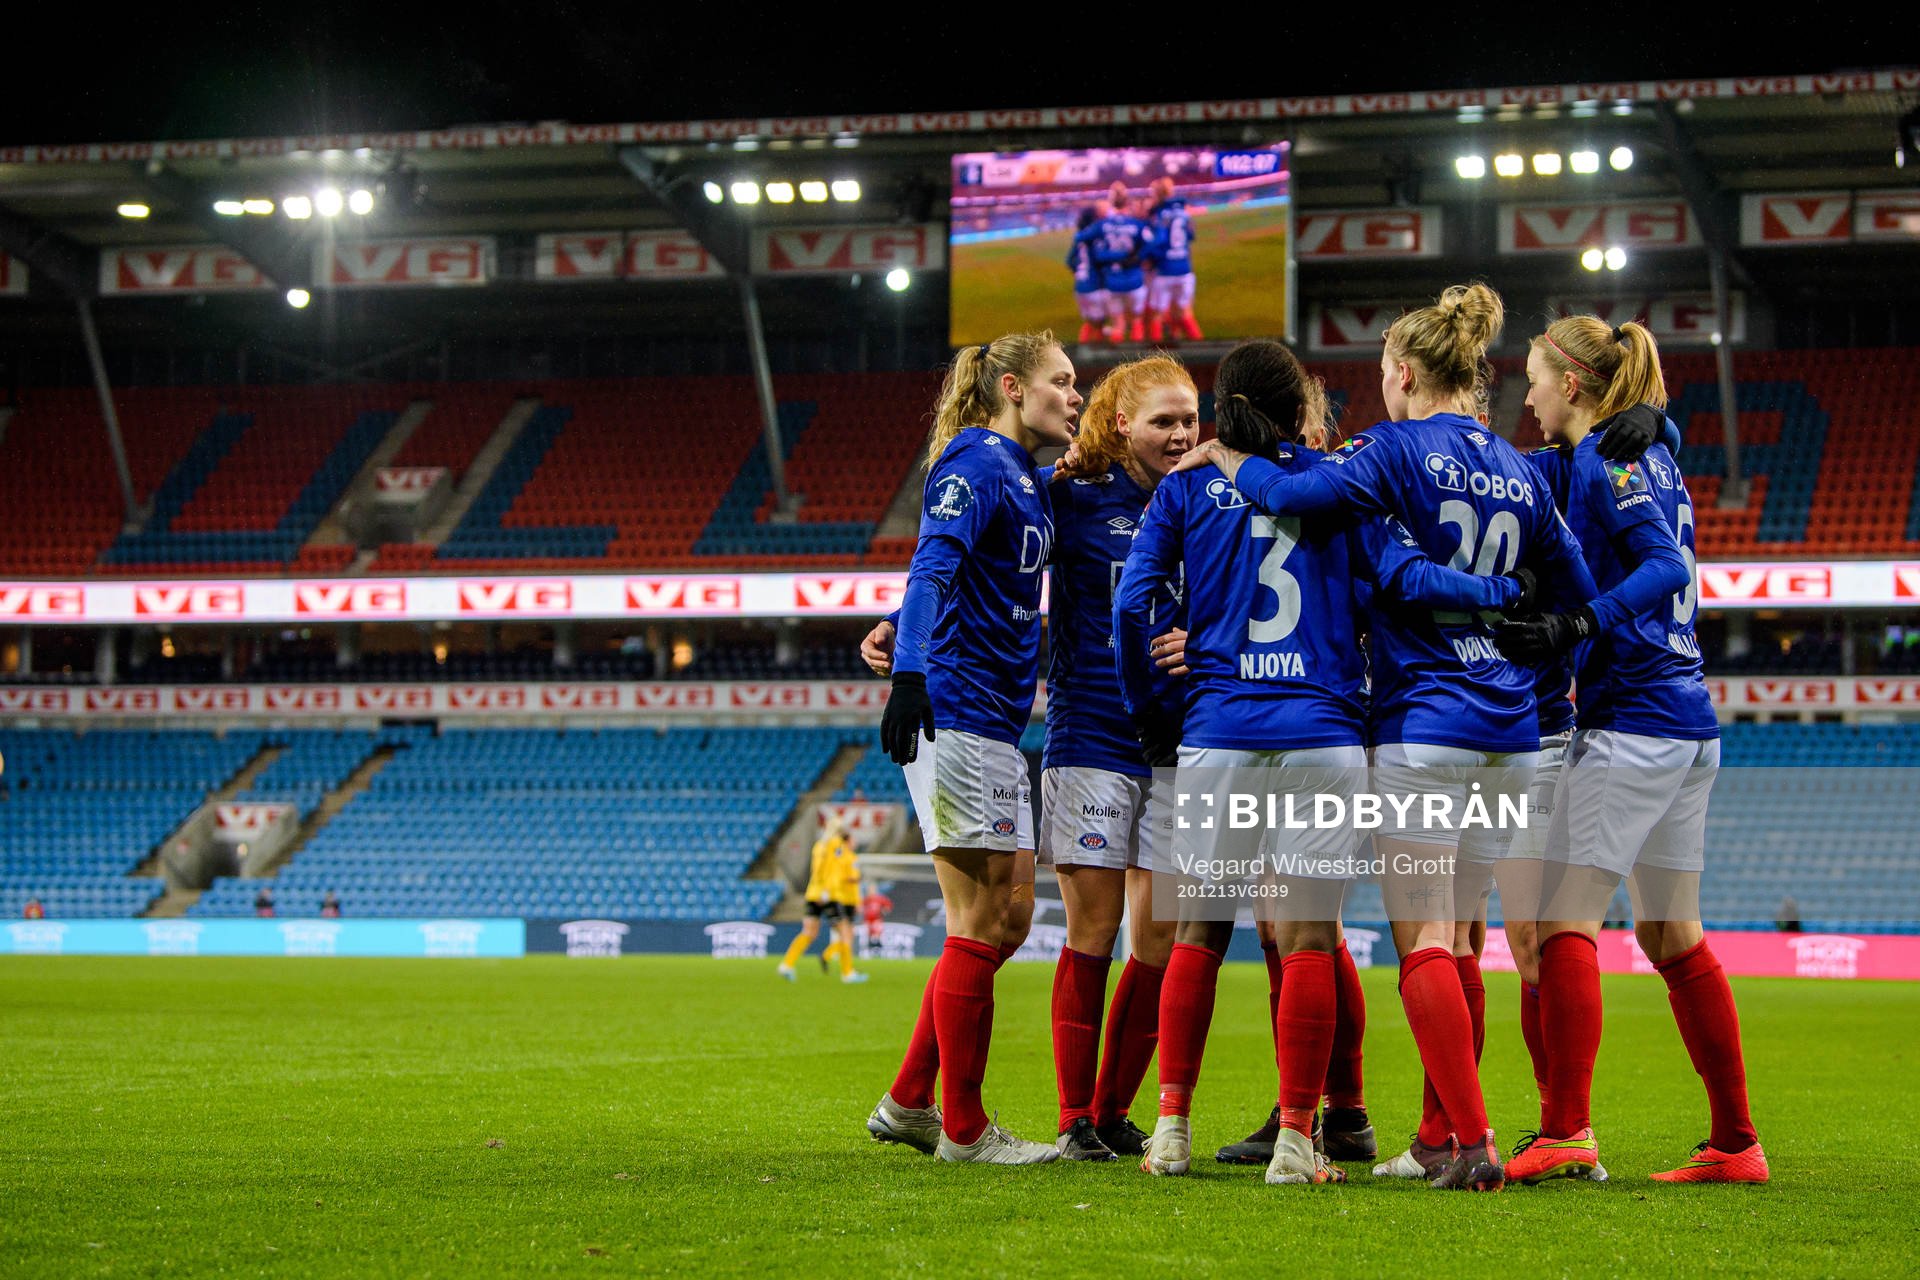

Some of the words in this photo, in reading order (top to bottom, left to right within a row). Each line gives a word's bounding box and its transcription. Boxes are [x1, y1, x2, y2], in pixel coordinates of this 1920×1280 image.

[1515, 204, 1687, 247] VG
[118, 250, 265, 288] VG
[332, 241, 481, 285] VG
[555, 237, 708, 276] VG
[769, 228, 927, 271] VG
[1470, 471, 1533, 507] OBOS
[1616, 494, 1653, 511] umbro
[1110, 528, 1133, 536] umbro
[1249, 515, 1302, 643] 3
[1434, 500, 1521, 624] 20
[135, 585, 244, 615] VG
[296, 583, 405, 613] VG
[459, 581, 572, 611] VG
[626, 579, 741, 609] VG
[795, 577, 909, 607] VG
[1702, 569, 1832, 599] VG
[1240, 652, 1306, 679] NJOYA
[86, 688, 159, 711] VG
[173, 687, 249, 711] VG
[264, 687, 340, 711] VG
[356, 686, 433, 710] VG
[447, 686, 525, 709] VG
[541, 686, 618, 709] VG
[635, 685, 714, 708] VG
[730, 684, 809, 708] VG
[1746, 681, 1835, 703] VG
